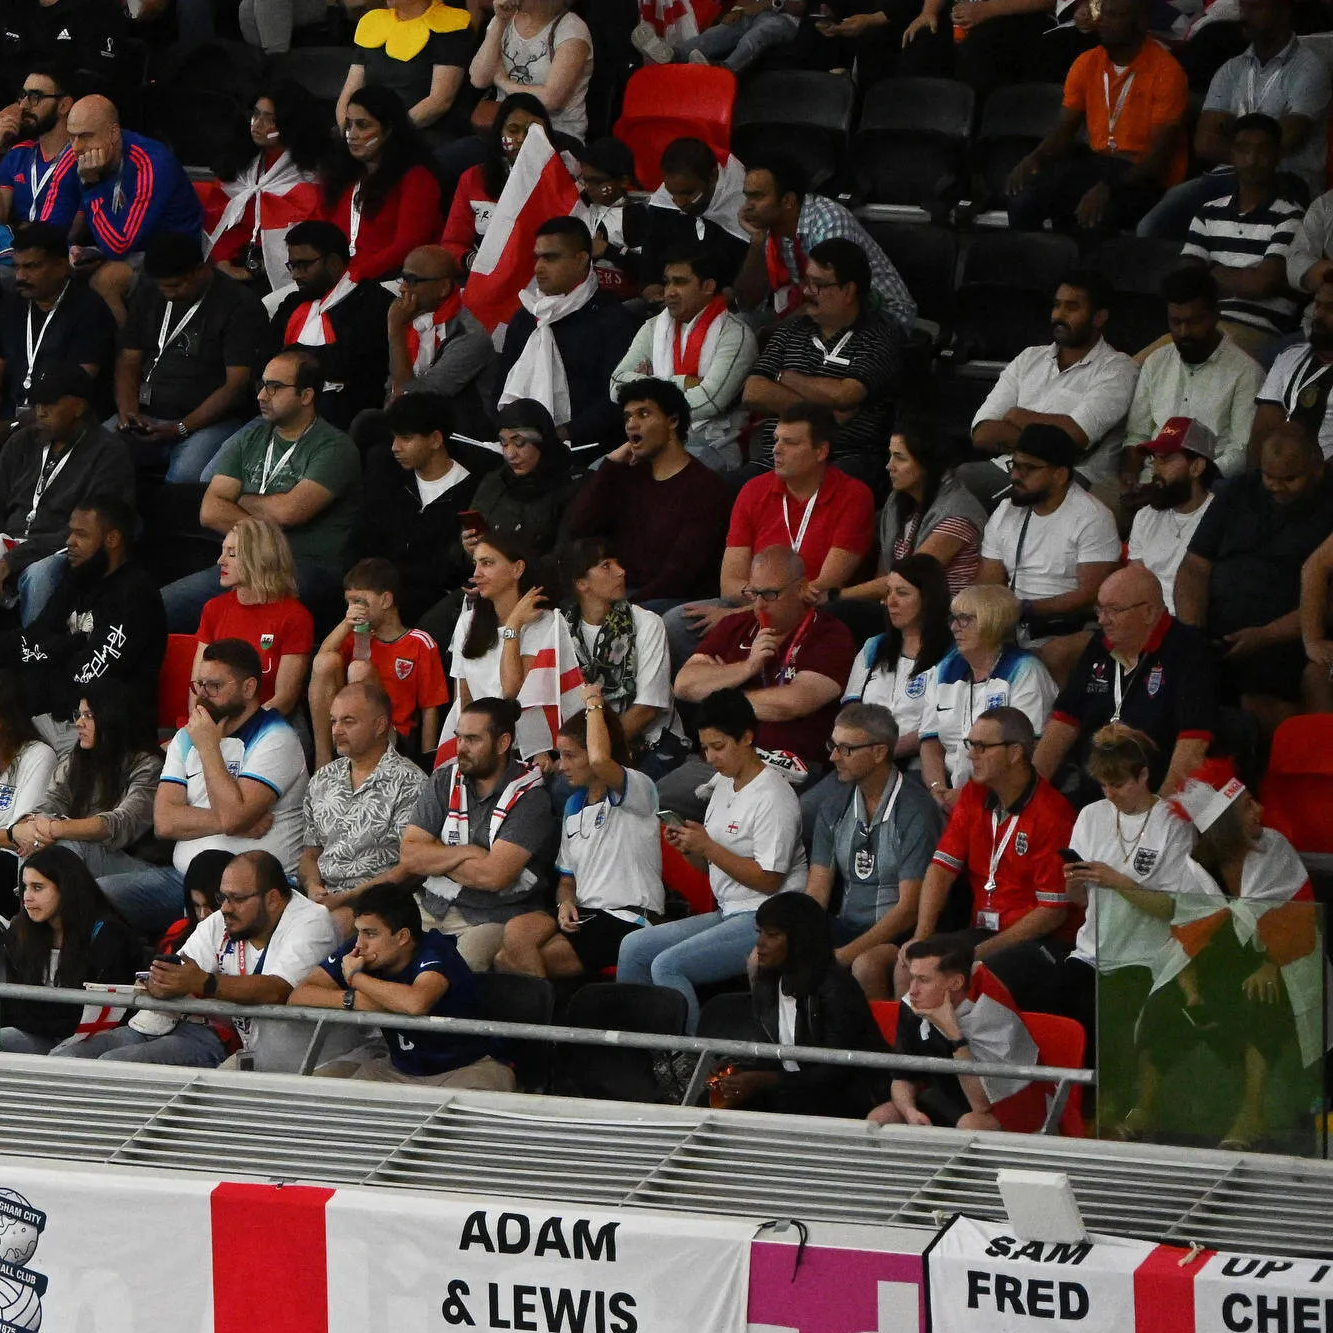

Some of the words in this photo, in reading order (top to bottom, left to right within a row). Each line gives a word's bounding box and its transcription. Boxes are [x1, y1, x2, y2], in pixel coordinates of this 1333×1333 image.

[23, 1210, 42, 1225] CITY
[458, 1210, 621, 1262] ADAM
[984, 1235, 1095, 1266] SAM
[16, 1267, 37, 1285] CLUB
[1221, 1257, 1292, 1279] UP
[441, 1279, 477, 1327] &
[966, 1269, 1090, 1322] FRED
